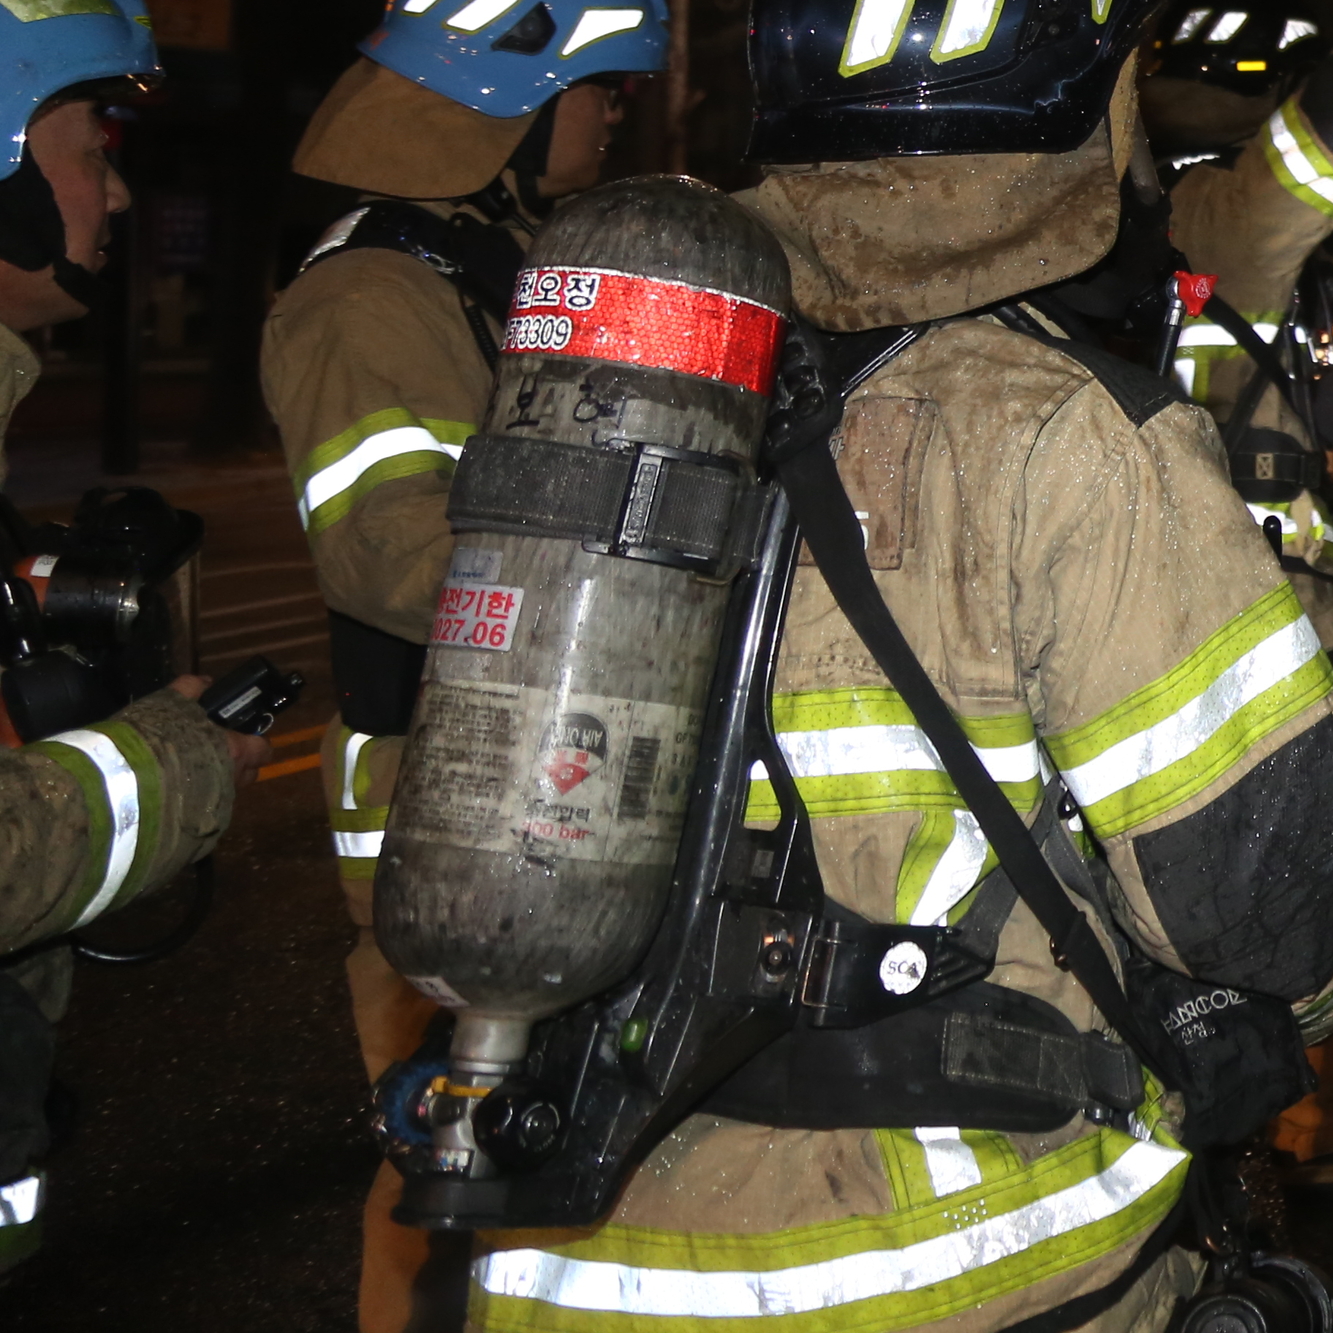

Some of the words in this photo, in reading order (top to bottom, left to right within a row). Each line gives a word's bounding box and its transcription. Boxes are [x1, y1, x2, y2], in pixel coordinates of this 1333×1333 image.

[514, 271, 600, 311] 천오정
[502, 314, 573, 351] F73309
[583, 729, 604, 748] AIR
[558, 823, 591, 840] bar
[886, 959, 921, 980] SCA
